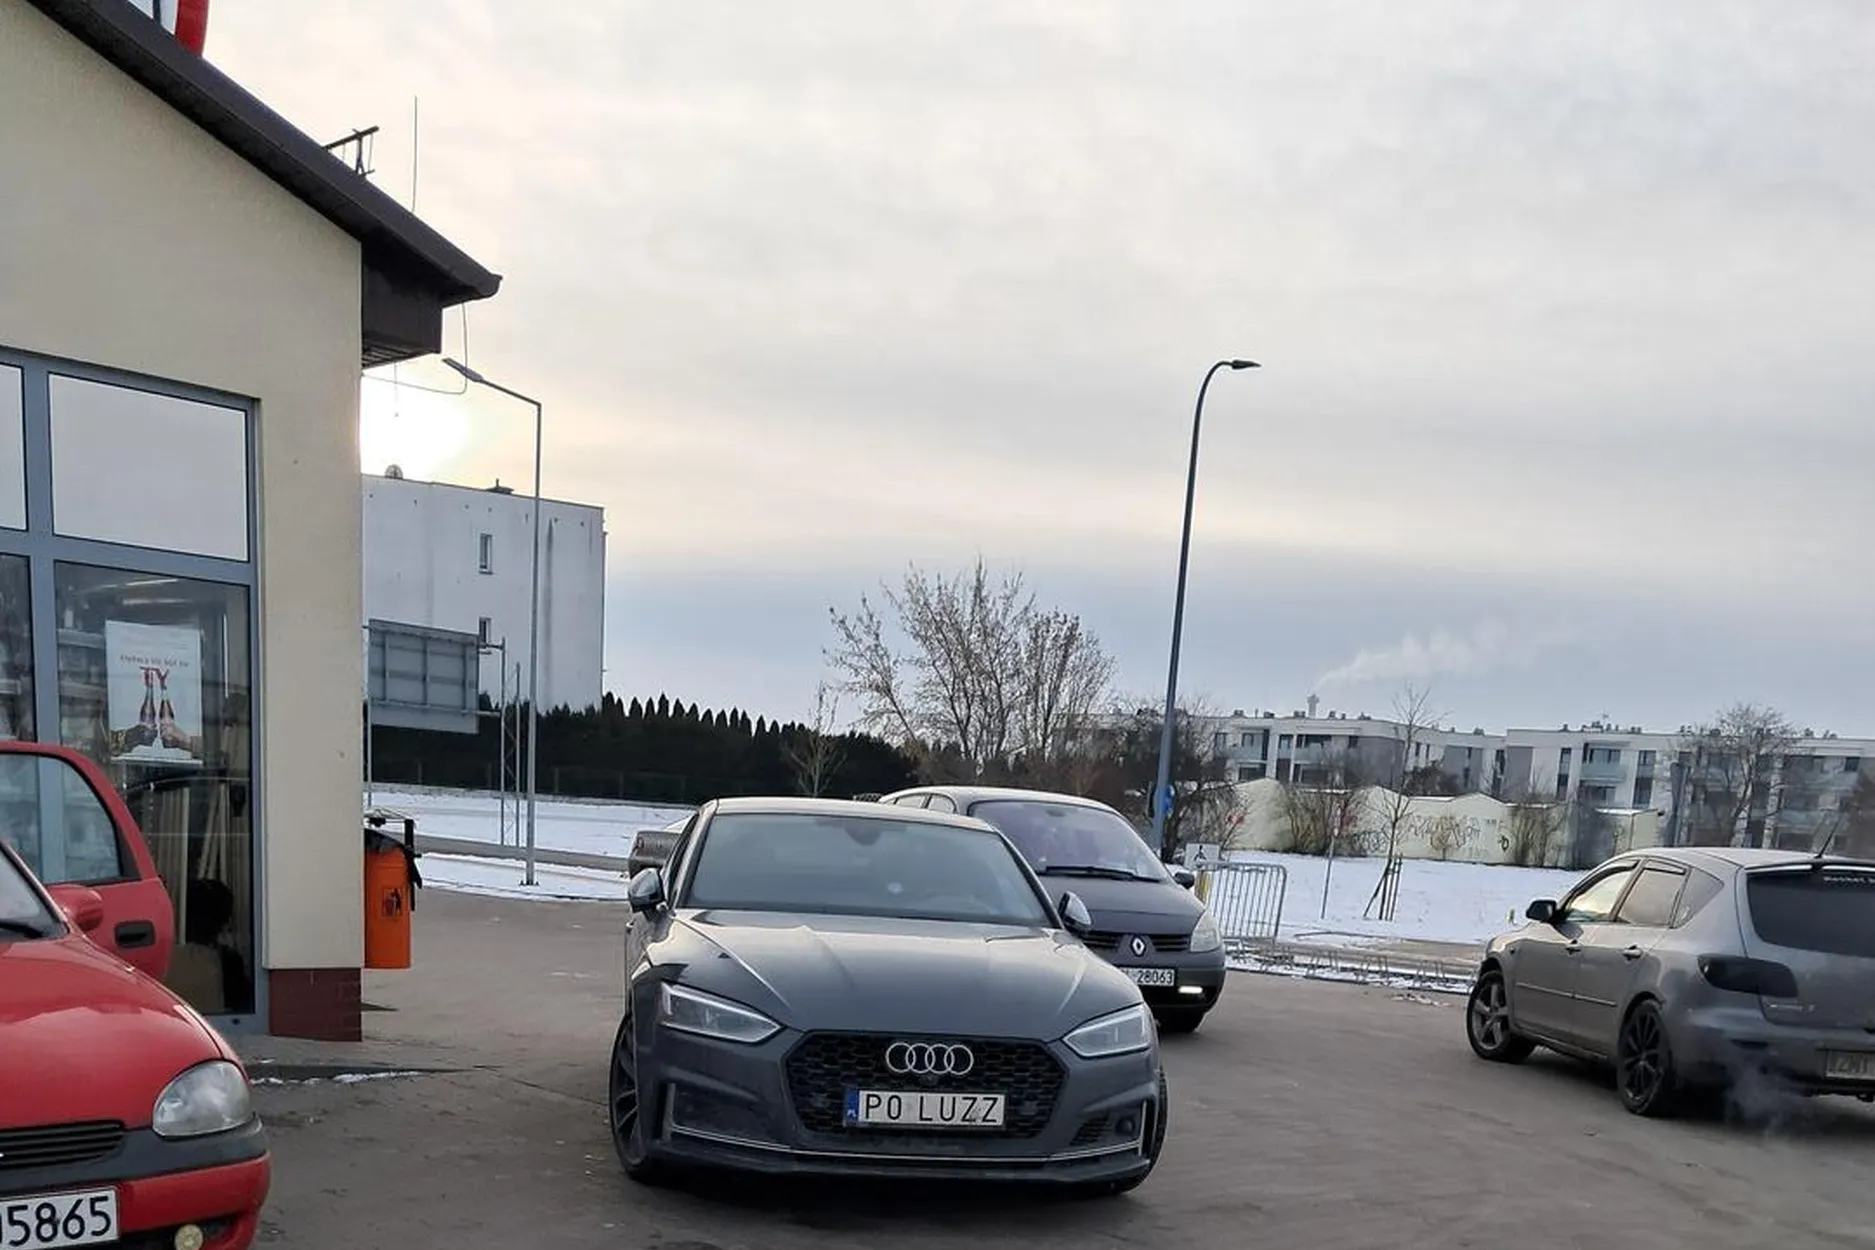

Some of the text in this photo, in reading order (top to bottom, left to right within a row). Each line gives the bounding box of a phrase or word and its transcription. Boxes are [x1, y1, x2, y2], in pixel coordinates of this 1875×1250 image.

[1136, 970, 1173, 985] 28063
[919, 1096, 999, 1123] LUZZ
[0, 1196, 111, 1247] 5865
